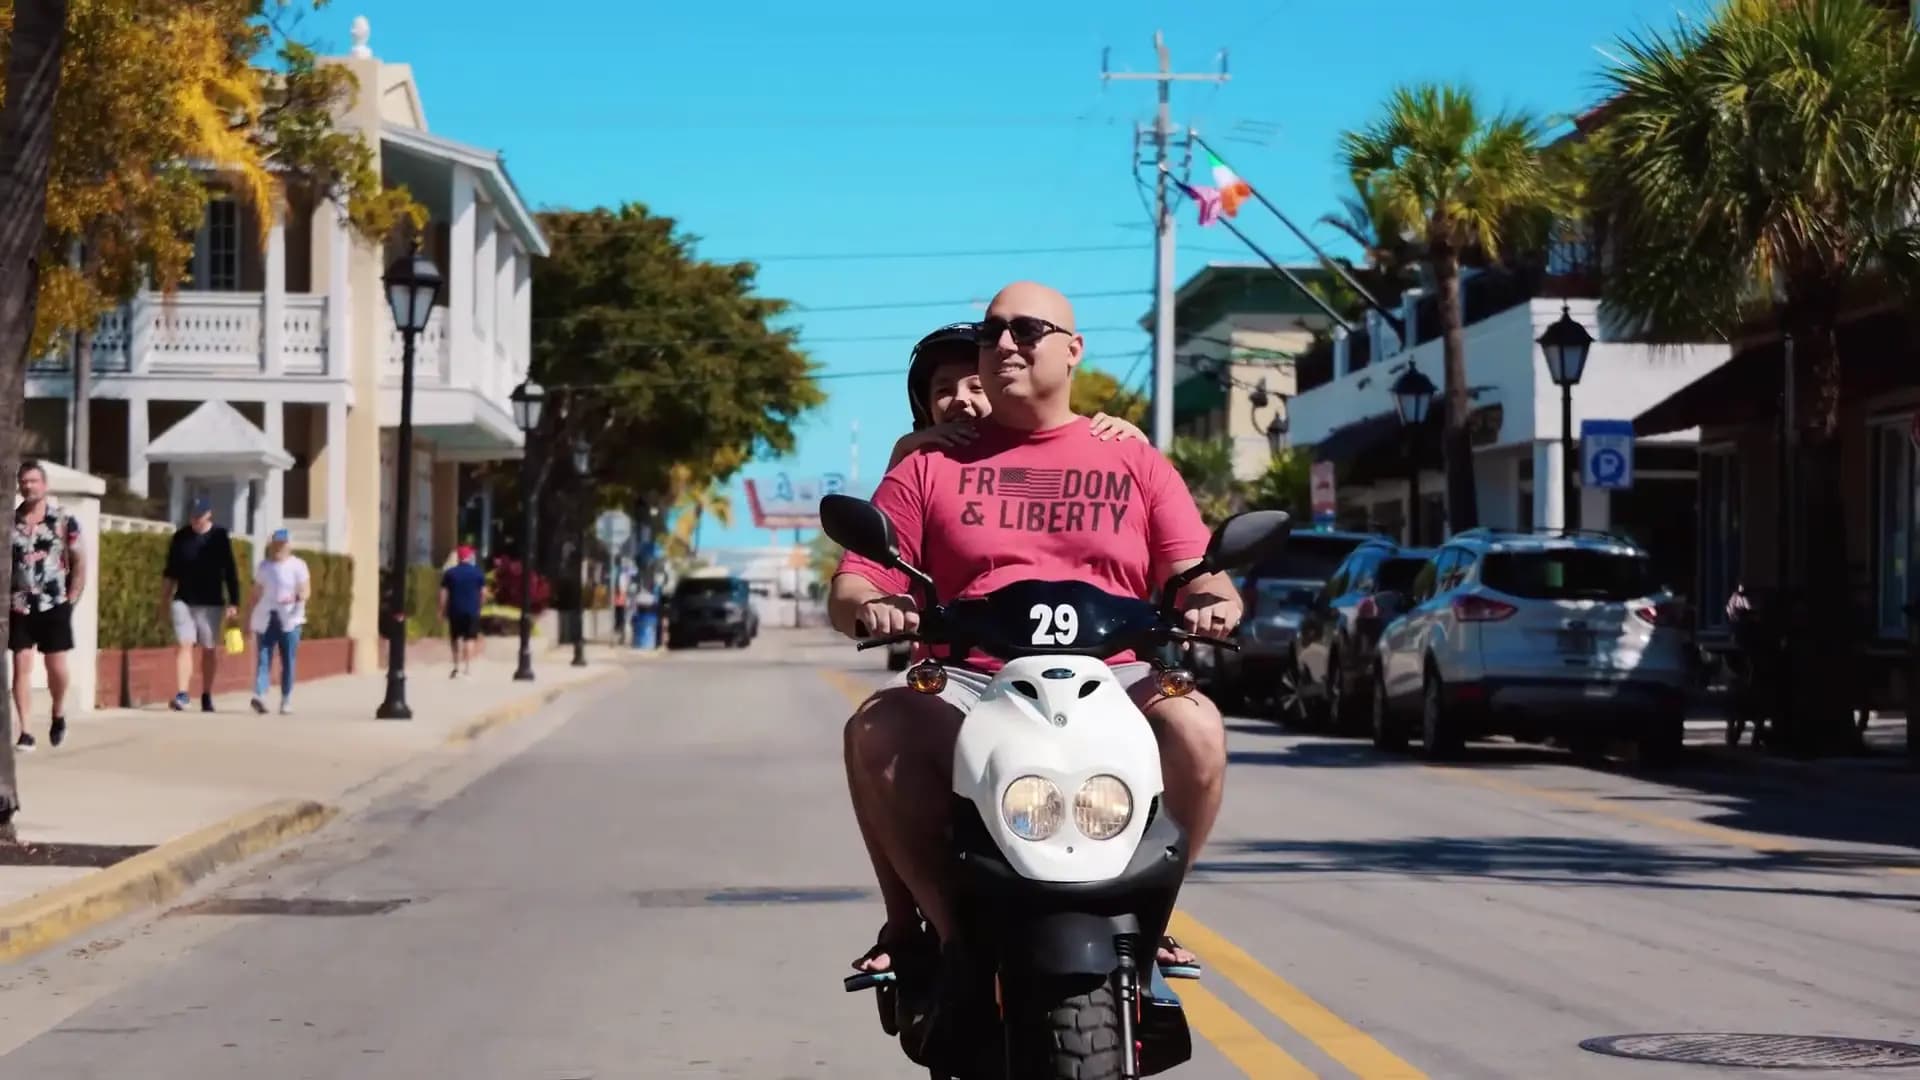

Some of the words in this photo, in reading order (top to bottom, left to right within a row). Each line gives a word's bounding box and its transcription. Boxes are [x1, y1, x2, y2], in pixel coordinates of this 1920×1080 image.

[960, 501, 985, 526] &
[999, 500, 1128, 535] LIBERTY
[1029, 603, 1079, 646] 29
